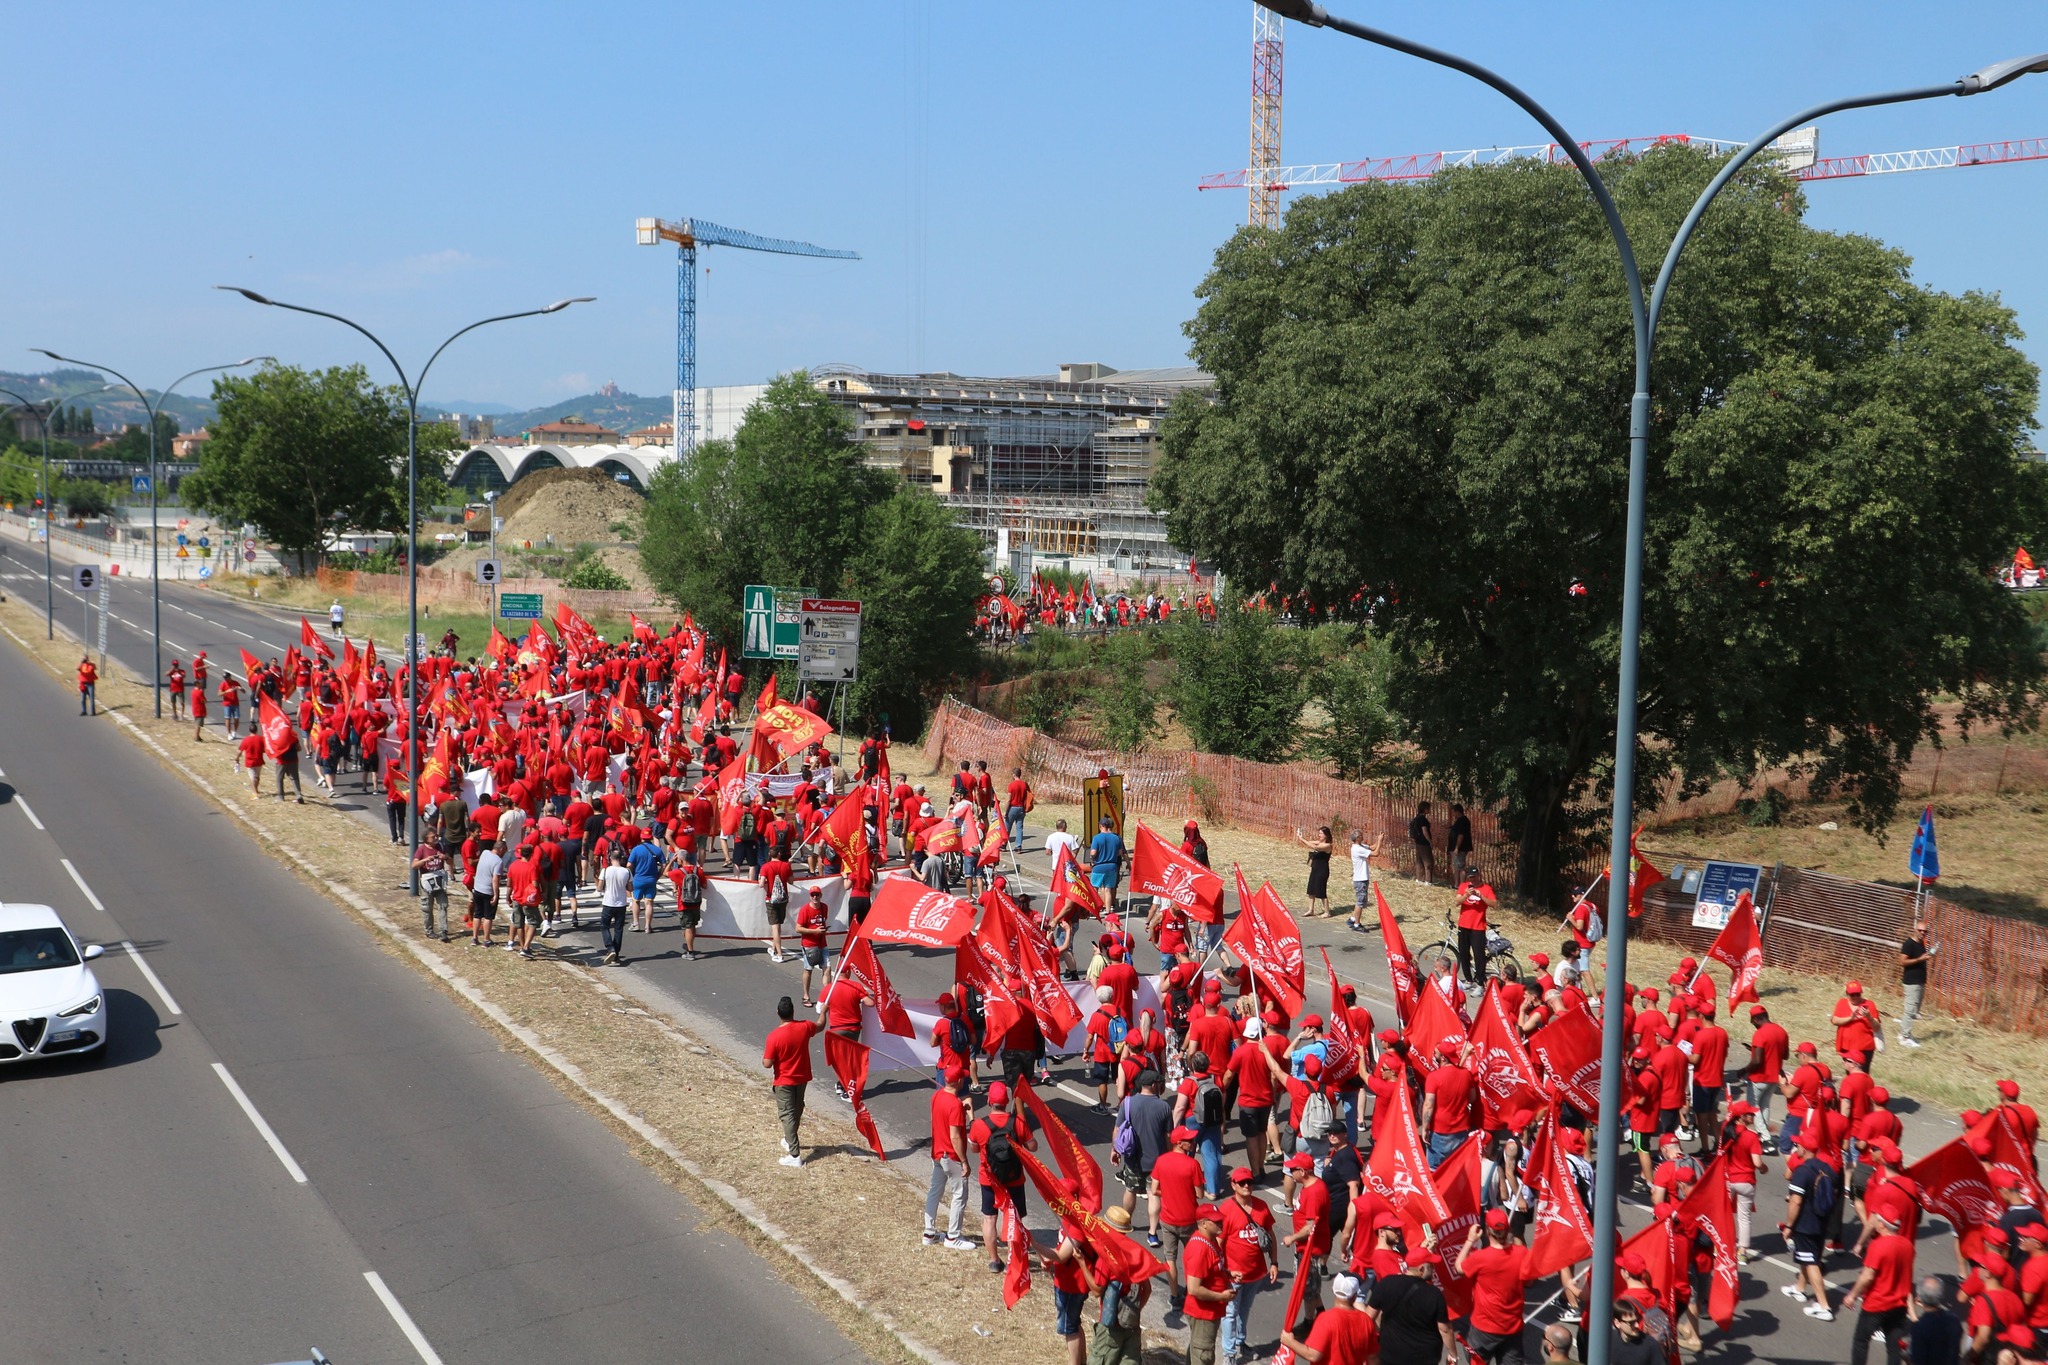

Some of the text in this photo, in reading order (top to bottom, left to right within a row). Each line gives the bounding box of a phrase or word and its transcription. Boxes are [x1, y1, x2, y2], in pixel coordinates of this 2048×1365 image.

[819, 604, 856, 612] BolognaFiere
[991, 602, 999, 612] 40
[1158, 840, 1180, 856] IMPIEGATI
[1070, 884, 1096, 910] IMOLA
[1143, 881, 1173, 896] Fiom-C
[872, 927, 943, 946] Fiom-Cgil MODENA
[920, 919, 942, 928] FIOM
[982, 941, 1016, 974] Fiom-Cgil
[1233, 941, 1287, 1001] FiomCgil MODENA
[1502, 1018, 1517, 1047] IMPIEGATI
[1515, 1046, 1531, 1070] OPERAI
[1536, 1047, 1569, 1094] Fiom-Cgil
[1403, 1113, 1416, 1148] IMPIEGATI
[1411, 1147, 1424, 1174] OPERAI
[1420, 1174, 1447, 1220] METALLURGICI
[1560, 1177, 1574, 1205] OPERAI
